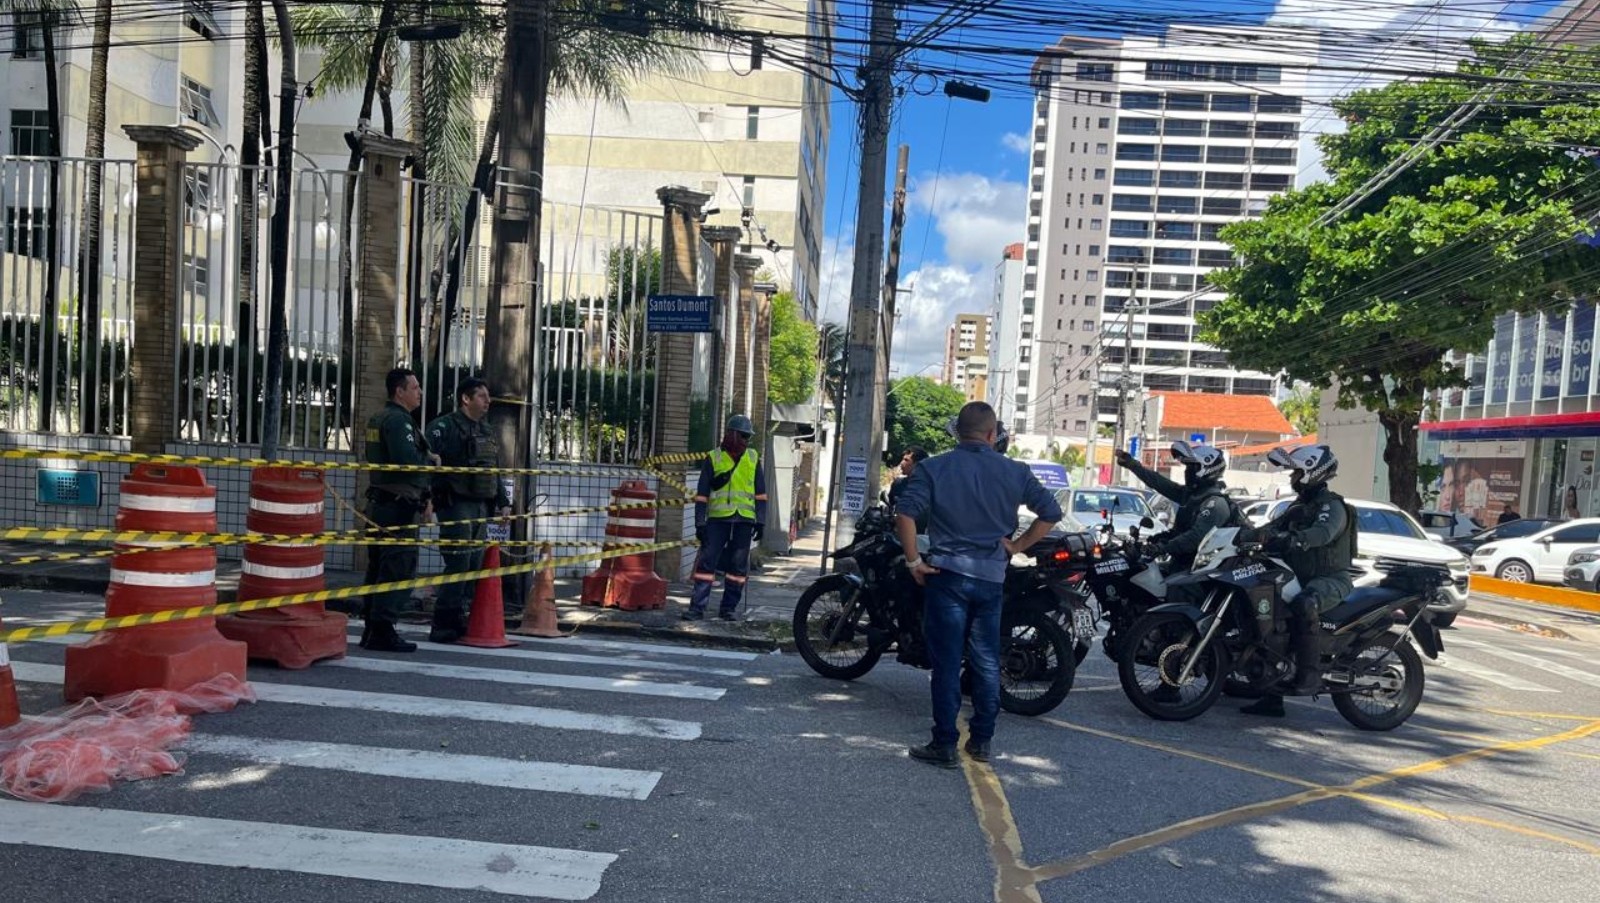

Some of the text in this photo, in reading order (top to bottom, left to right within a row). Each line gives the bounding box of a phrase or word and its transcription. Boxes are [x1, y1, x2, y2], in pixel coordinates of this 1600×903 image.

[649, 299, 708, 312] Santos Dumont
[1234, 566, 1266, 581] MILITAR
